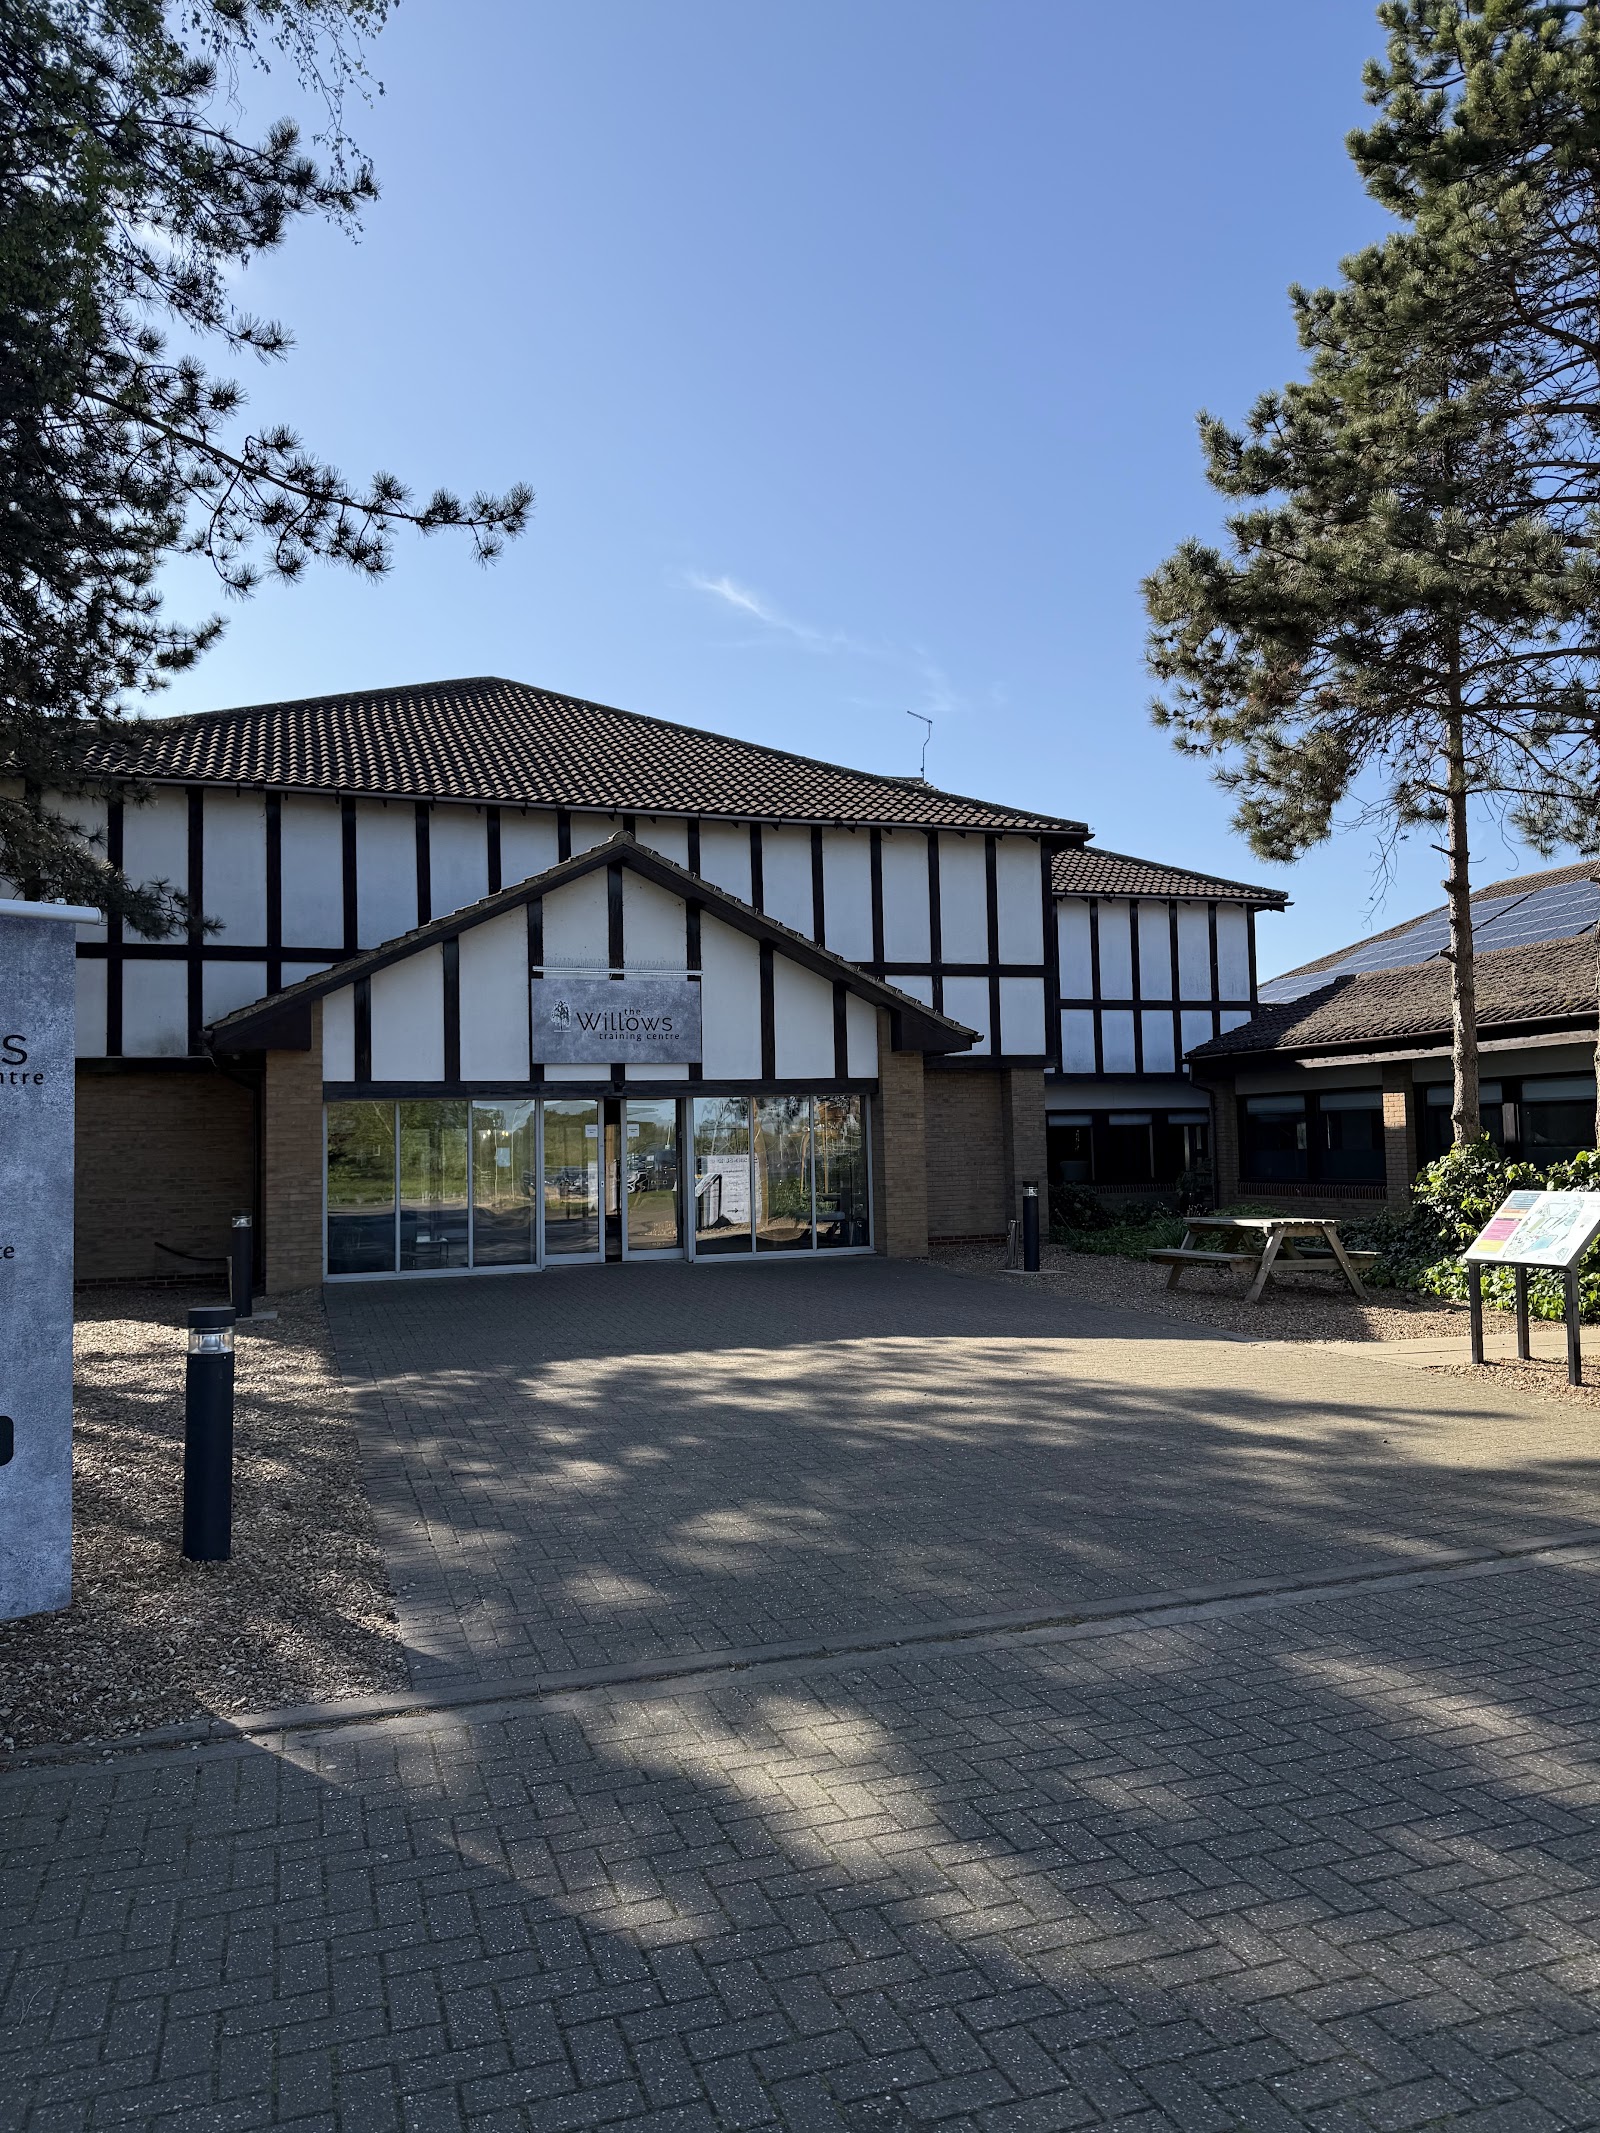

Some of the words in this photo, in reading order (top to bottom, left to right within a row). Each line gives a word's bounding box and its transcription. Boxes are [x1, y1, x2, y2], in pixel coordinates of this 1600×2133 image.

[624, 1007, 641, 1016] the
[576, 1012, 673, 1031] Willows
[599, 1032, 642, 1042] training
[646, 1032, 680, 1040] centre
